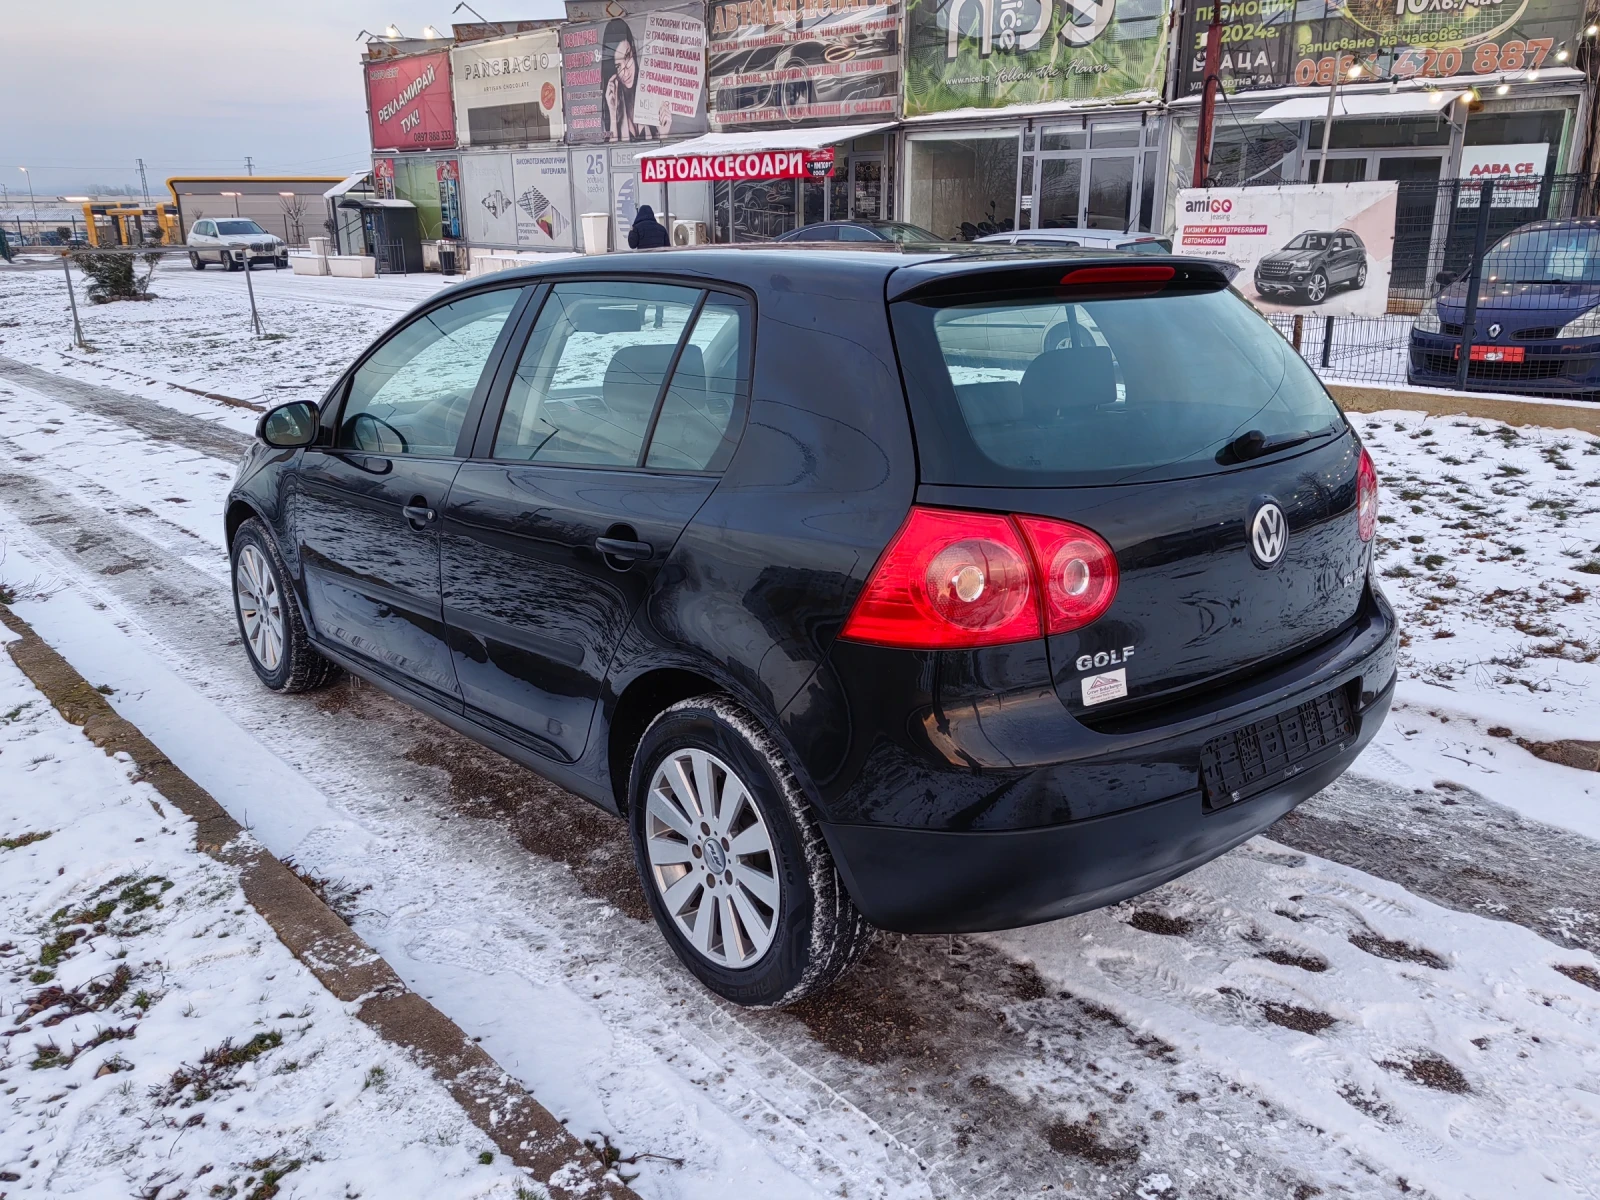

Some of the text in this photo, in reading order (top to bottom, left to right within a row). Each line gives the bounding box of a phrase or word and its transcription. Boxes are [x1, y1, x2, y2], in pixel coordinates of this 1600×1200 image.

[1379, 35, 1398, 46] на
[1402, 27, 1463, 44] часове:
[675, 49, 701, 62] РЕКЛАМА
[1192, 50, 1276, 72] ВАЦА,
[1390, 47, 1463, 77] 420
[1472, 38, 1554, 74] 887
[464, 53, 550, 80] PANCRACIO
[673, 62, 698, 75] РЕКЛАМА
[845, 59, 884, 73] КСЕНОНИ
[995, 66, 1033, 86] Follow
[1035, 63, 1061, 79] the
[1064, 58, 1110, 79] Flavor
[378, 63, 436, 125] РЕКЛАМИРАЙ
[503, 82, 529, 90] CHOCOLATE
[400, 109, 420, 134] ТУК!
[441, 130, 452, 140] 333
[586, 154, 604, 175] 25
[644, 152, 803, 180] АВТОАКСЕСОАРИ
[1469, 162, 1535, 177] ДАВА СЕ
[1210, 214, 1231, 222] leasing
[1218, 226, 1266, 234] УПОТРЕБЯВАНИ
[1075, 645, 1136, 672] GOLF
